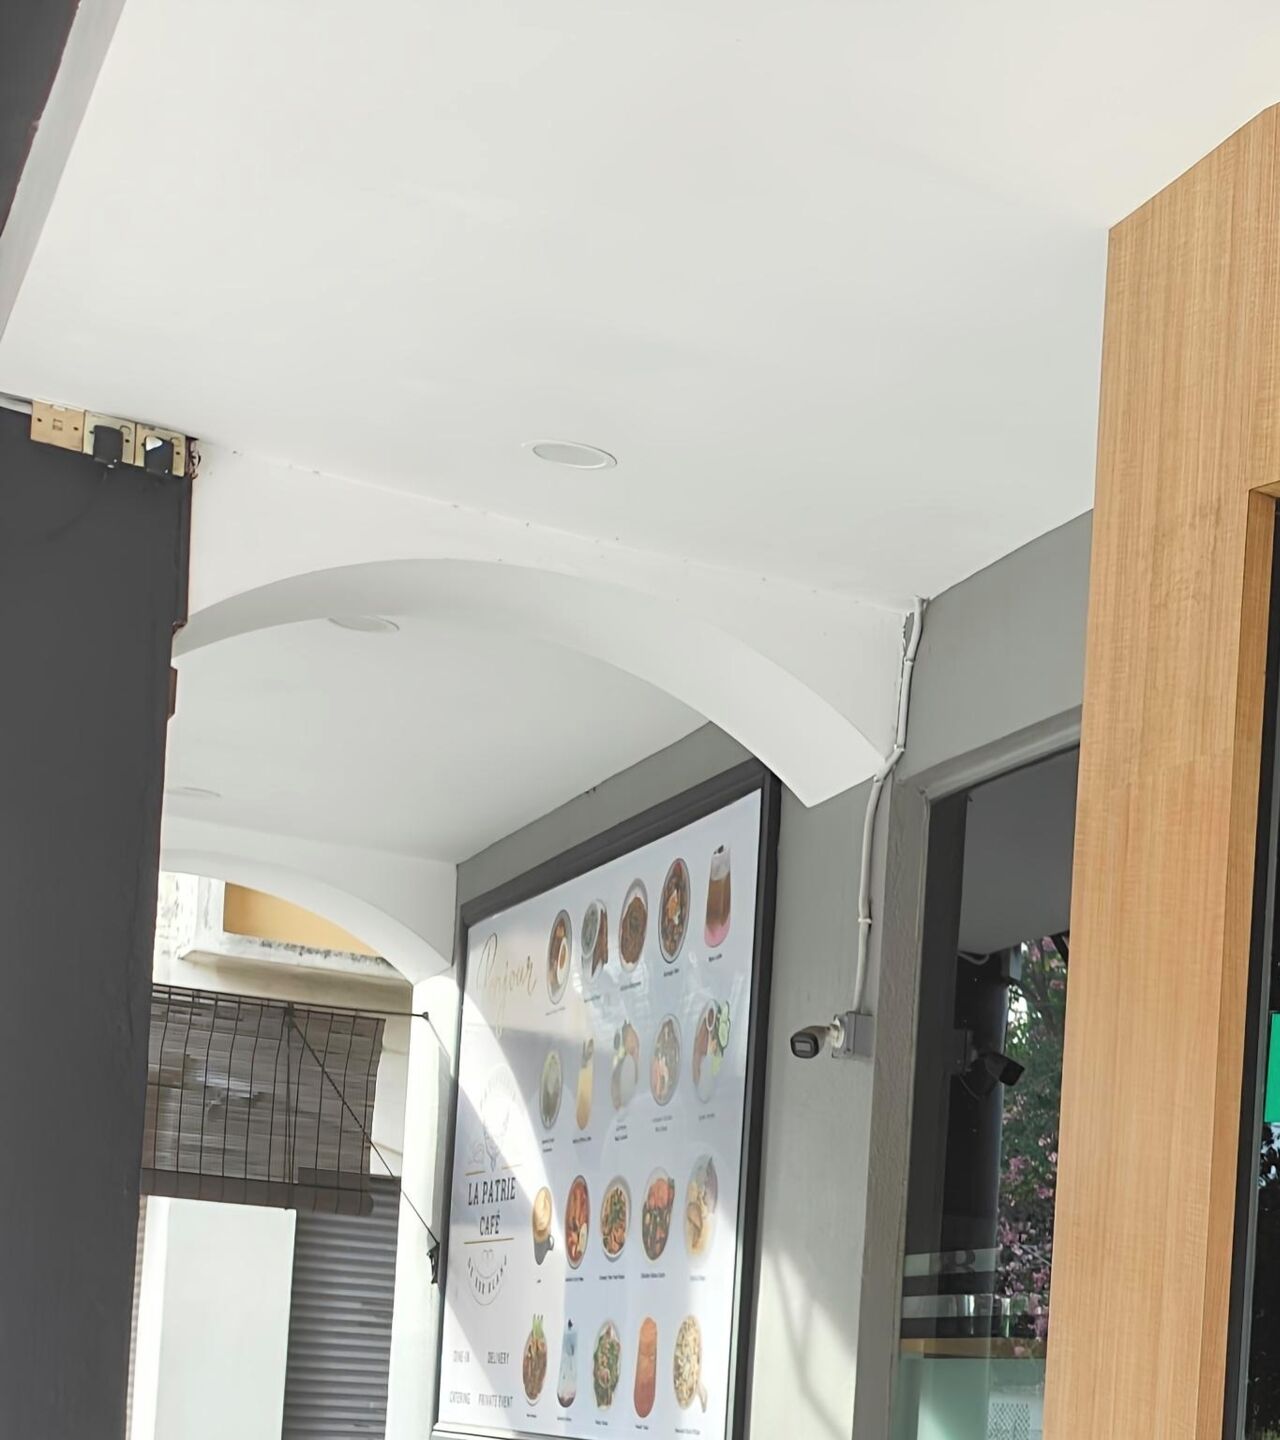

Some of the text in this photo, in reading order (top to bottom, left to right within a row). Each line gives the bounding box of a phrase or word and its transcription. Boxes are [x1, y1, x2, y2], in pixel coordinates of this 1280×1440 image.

[468, 1177, 516, 1206] LA PATRIE
[479, 1209, 500, 1236] CAFÉ
